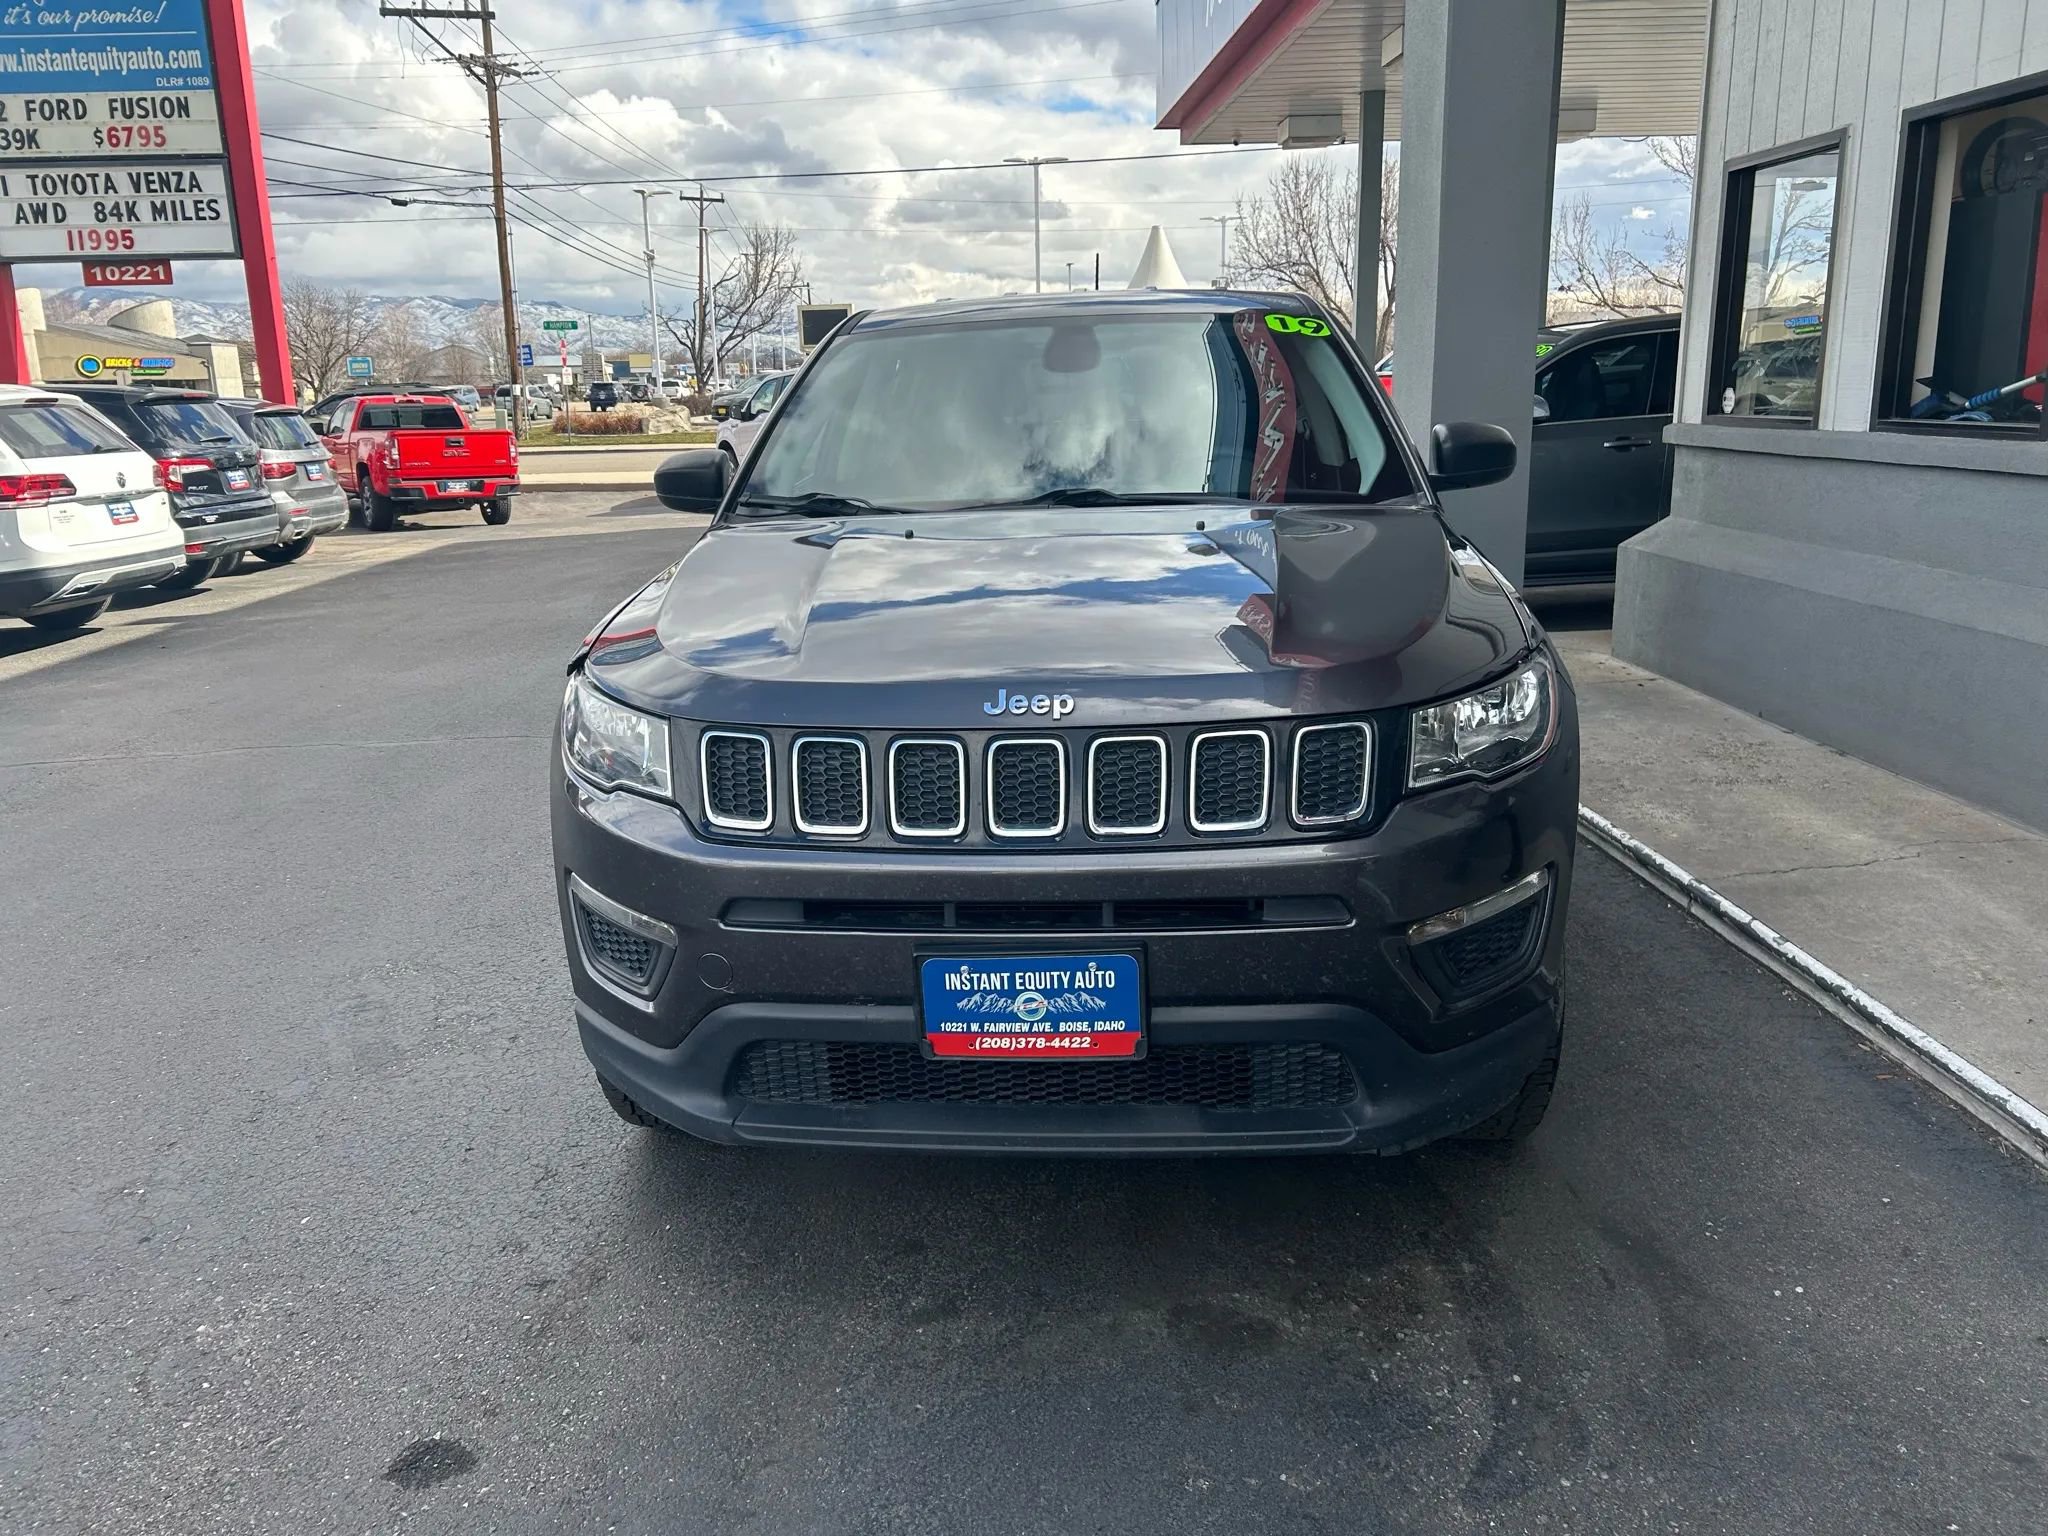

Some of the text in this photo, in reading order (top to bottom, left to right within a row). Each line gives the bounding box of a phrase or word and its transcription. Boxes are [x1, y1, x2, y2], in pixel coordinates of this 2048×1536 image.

[4, 1, 167, 32] it's our promise!
[156, 76, 209, 87] DLR# 1089
[24, 98, 88, 121] FORD
[108, 96, 190, 119] FUSION
[93, 125, 167, 148] $6795
[25, 173, 119, 196] TOYOTA
[127, 171, 203, 194] VENZA
[15, 199, 220, 225] AWD 84K MILES
[66, 229, 135, 251] 11995
[90, 265, 166, 281] 10221
[1272, 316, 1326, 334] 19
[105, 358, 132, 369] BRICKS
[983, 688, 1075, 720] Jeep
[944, 970, 1115, 991] INSTANT EQUITY AUTO
[940, 1020, 1126, 1034] 10221 W. FAIRVIEW AVE. BOISE, IDAHO
[975, 1036, 1092, 1051] (208)378-4422
